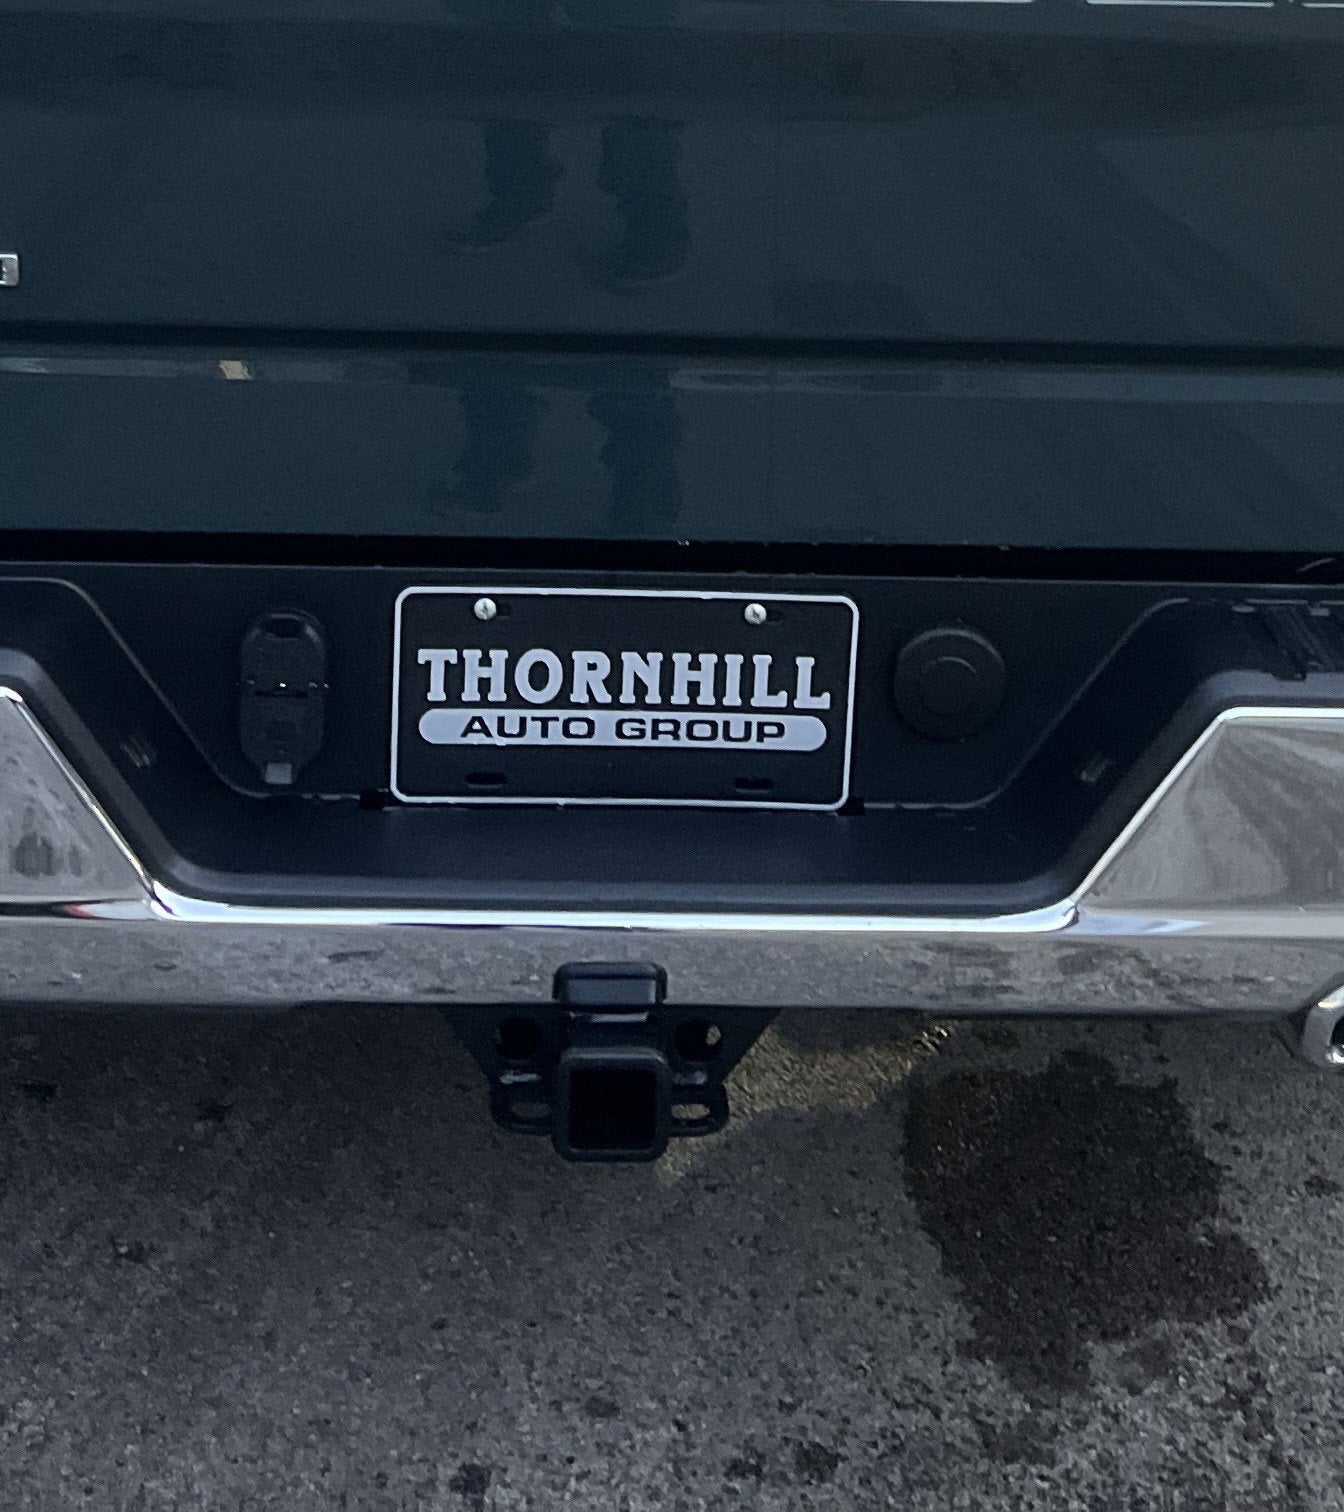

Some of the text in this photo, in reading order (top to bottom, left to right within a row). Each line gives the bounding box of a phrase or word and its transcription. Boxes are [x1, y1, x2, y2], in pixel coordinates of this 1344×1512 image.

[417, 648, 832, 710] THORNHILL
[460, 715, 787, 743] AUTO GROUP
